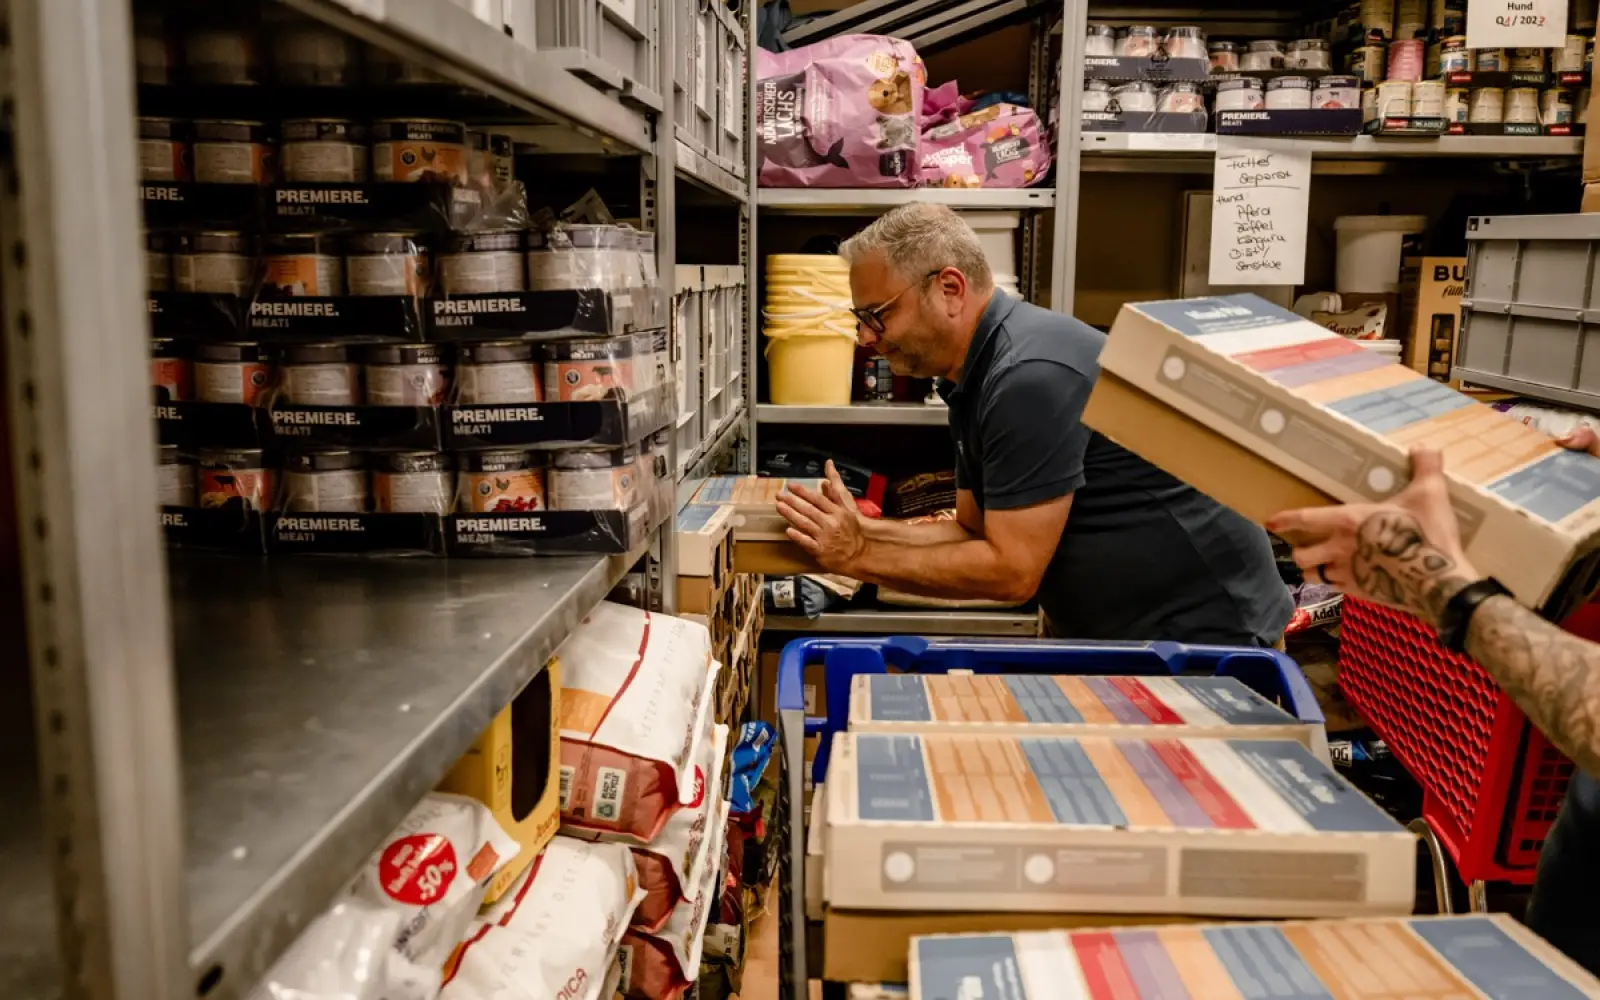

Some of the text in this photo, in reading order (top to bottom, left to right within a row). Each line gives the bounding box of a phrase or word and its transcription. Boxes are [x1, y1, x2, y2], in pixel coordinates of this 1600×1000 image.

[1507, 2, 1533, 11] Hund
[776, 90, 794, 138] LACHS
[1221, 111, 1270, 120] PREMIERE.
[275, 190, 369, 204] PREMIERE.
[1216, 193, 1244, 205] Hund
[1236, 204, 1271, 222] Pferd
[252, 302, 339, 317] PREMIERE.
[434, 298, 527, 314] PREMIERE.
[273, 411, 361, 425] PREMIERE.
[452, 408, 544, 423] PREMIERE.
[277, 517, 365, 532] PREMIERE.
[456, 517, 546, 532] PREMIERE.
